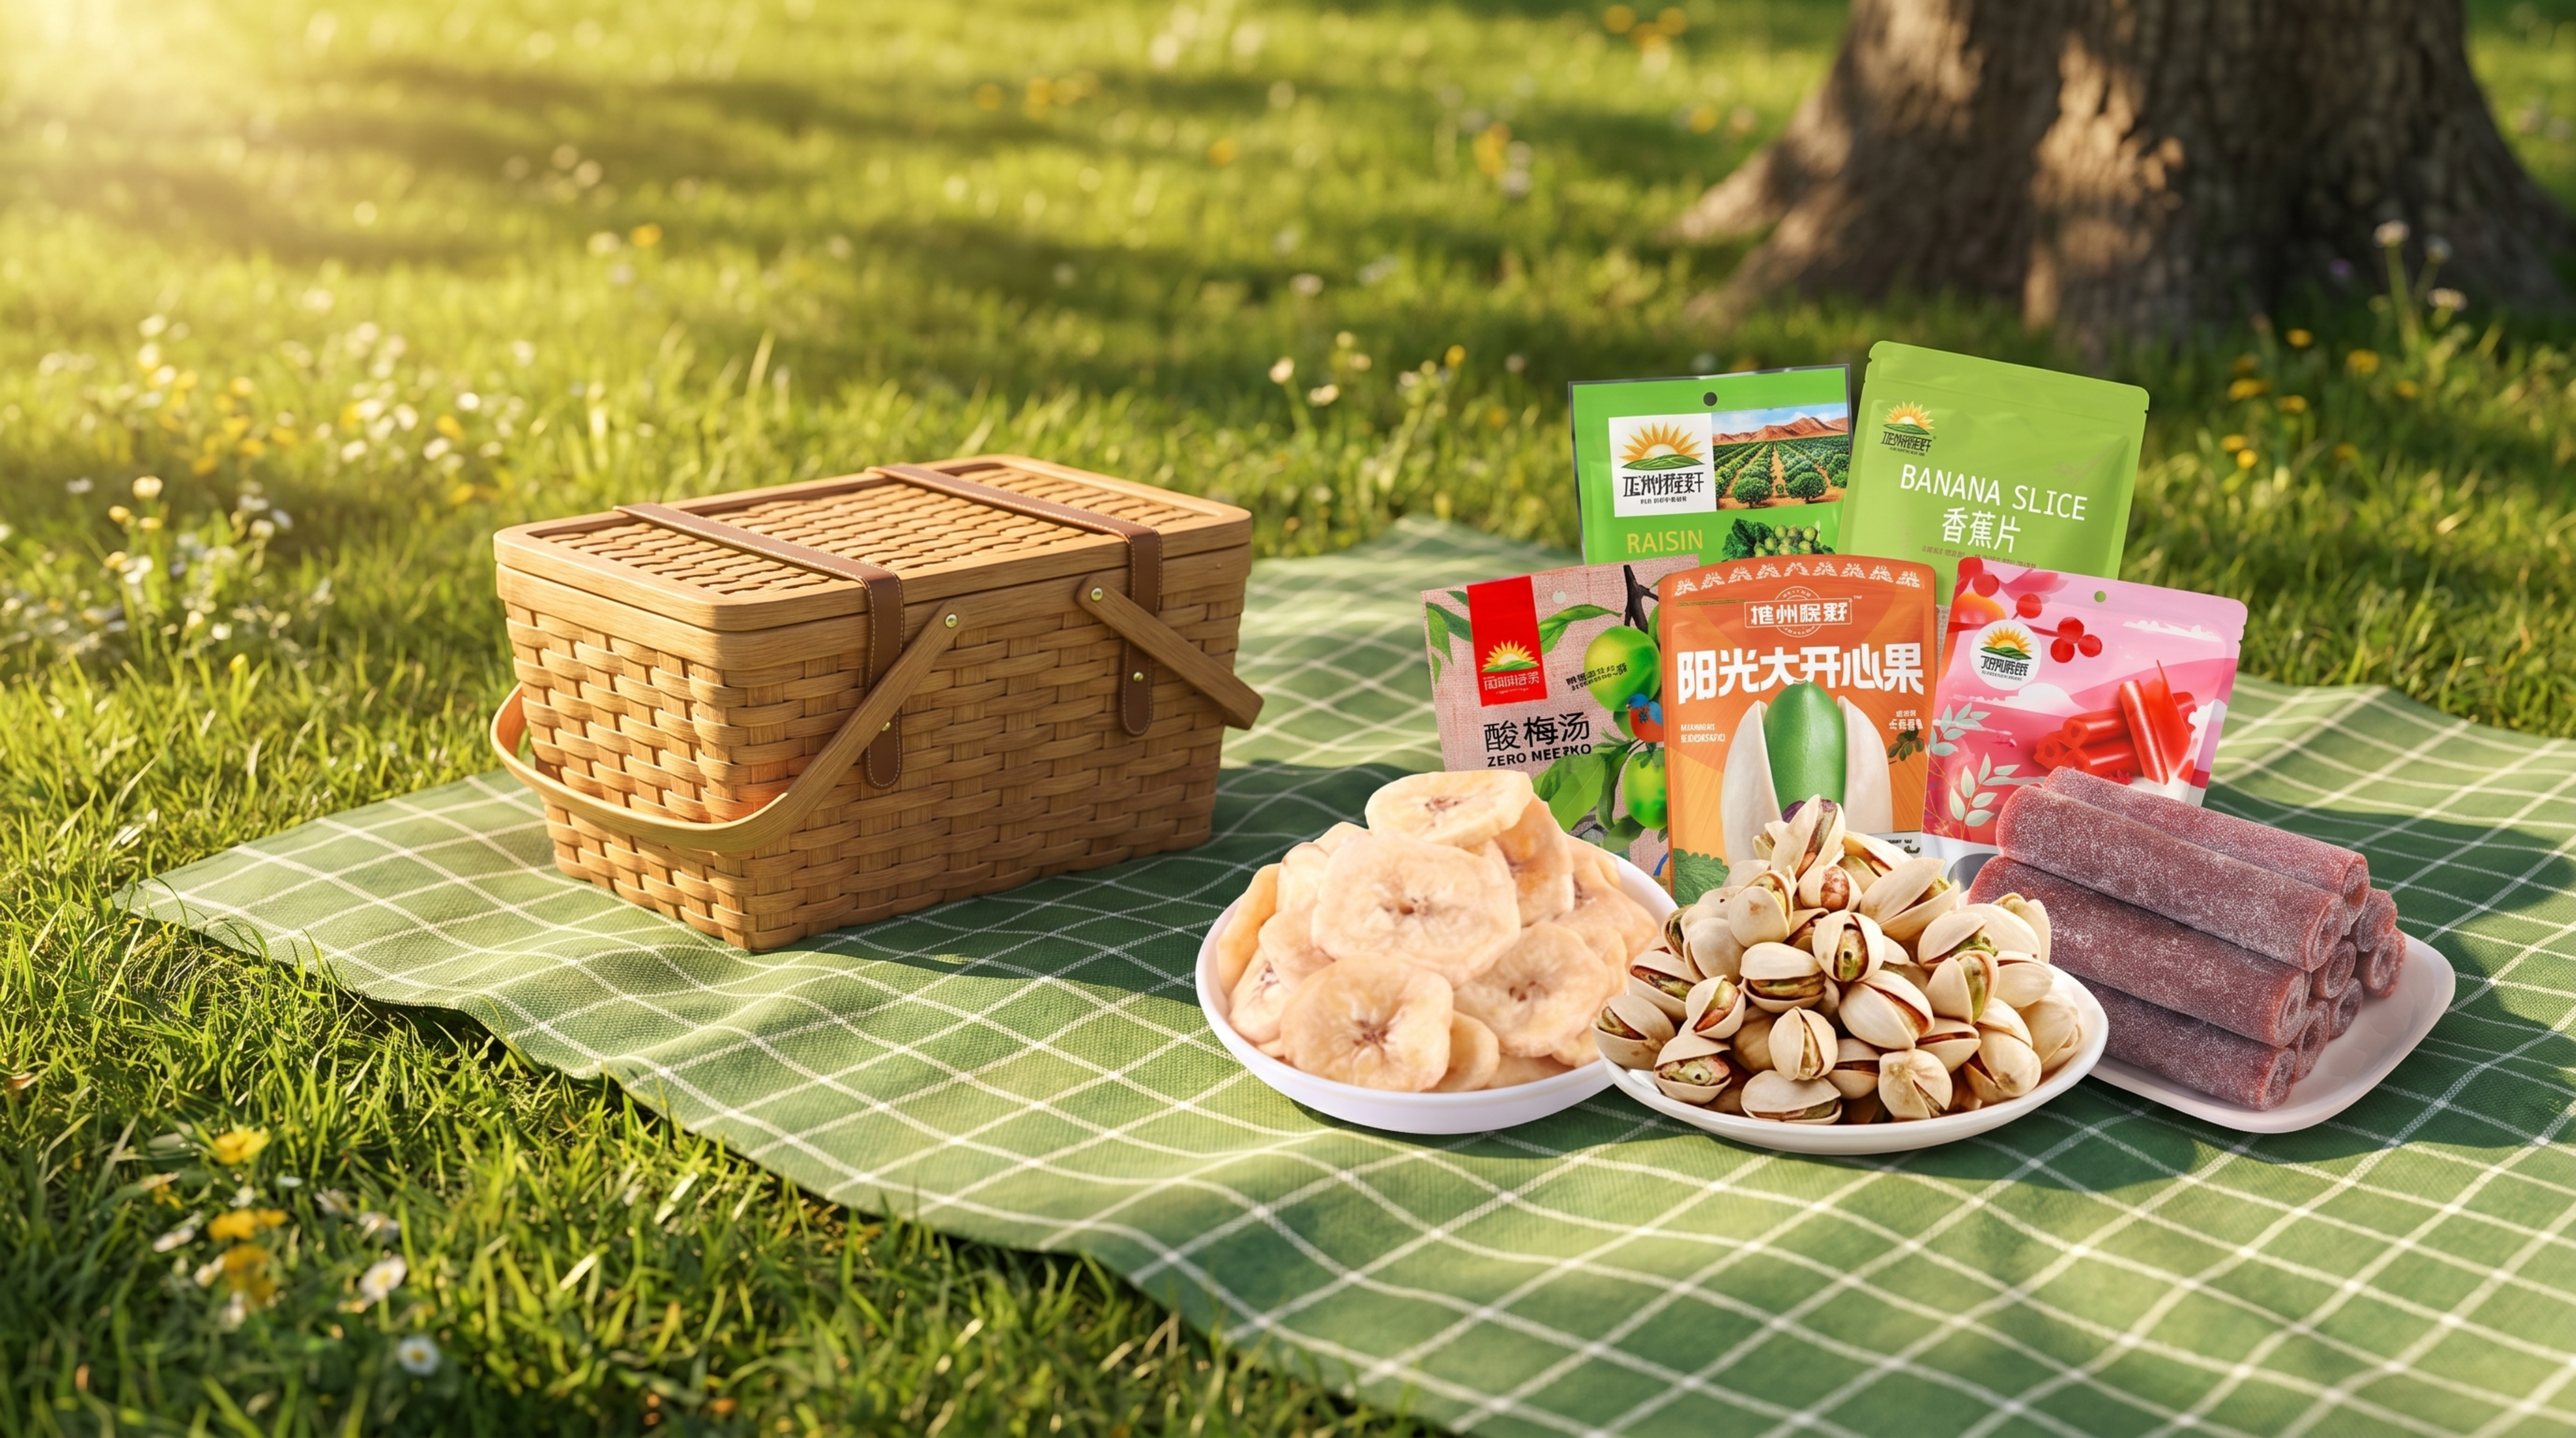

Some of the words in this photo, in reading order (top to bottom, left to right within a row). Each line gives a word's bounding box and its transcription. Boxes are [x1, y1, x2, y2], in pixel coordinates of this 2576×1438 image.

[1900, 464, 2001, 506] BANANA
[2012, 485, 2087, 521] SLICE
[1627, 530, 1703, 554] RAISIN
[1941, 506, 2021, 553] 香蕉片
[1677, 643, 1924, 705] 阳光大开心果
[1484, 711, 1590, 752] 酸梅汤
[1487, 753, 1526, 767] ZERO
